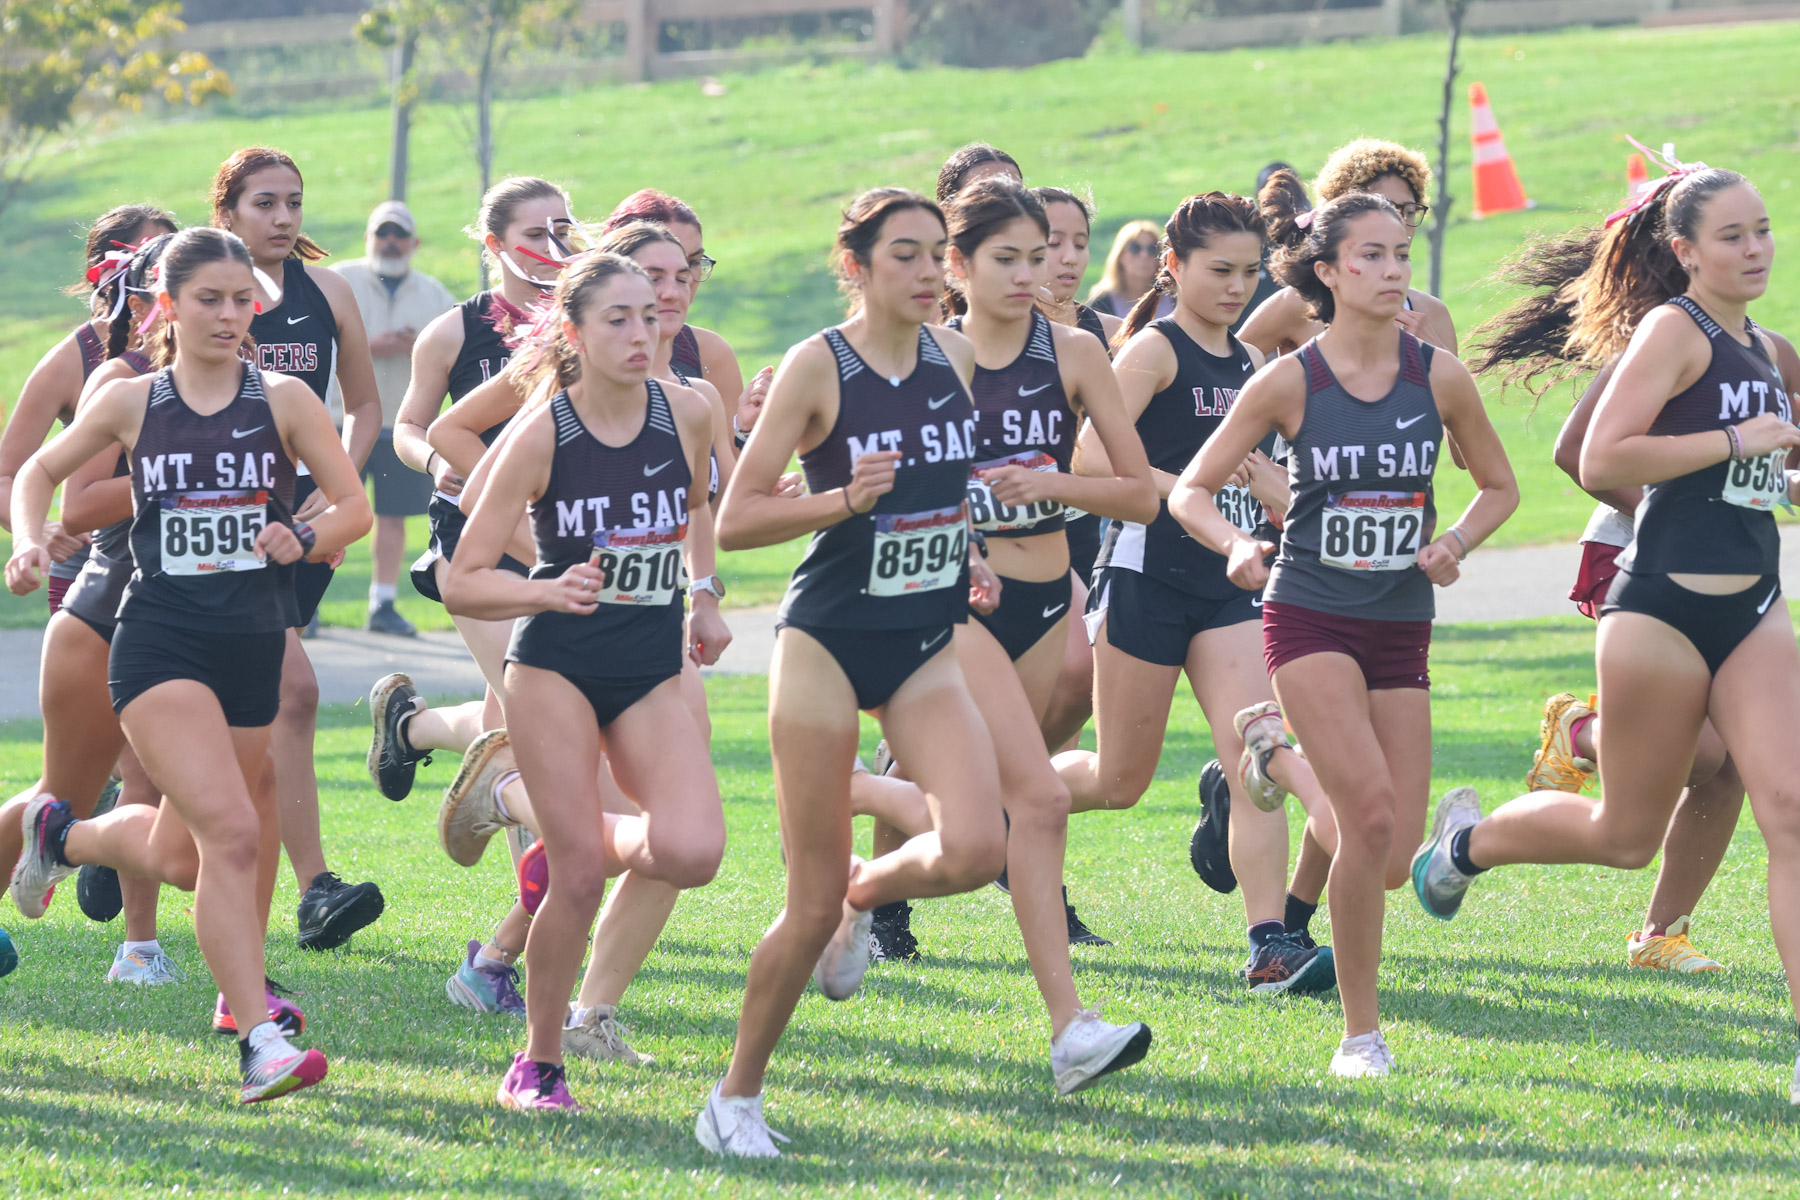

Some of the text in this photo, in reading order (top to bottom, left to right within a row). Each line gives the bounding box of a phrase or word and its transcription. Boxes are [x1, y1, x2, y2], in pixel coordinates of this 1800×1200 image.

[1719, 381, 1769, 420] MT
[921, 419, 976, 463] SAC
[1003, 410, 1062, 445] SAC
[141, 452, 275, 492] MT. SAC
[1311, 440, 1435, 481] MT SAC
[555, 487, 687, 537] MT. SAC
[166, 512, 262, 557] 8595
[877, 528, 965, 579] 8594
[1326, 514, 1419, 557] 8612
[598, 549, 680, 592] 8610
